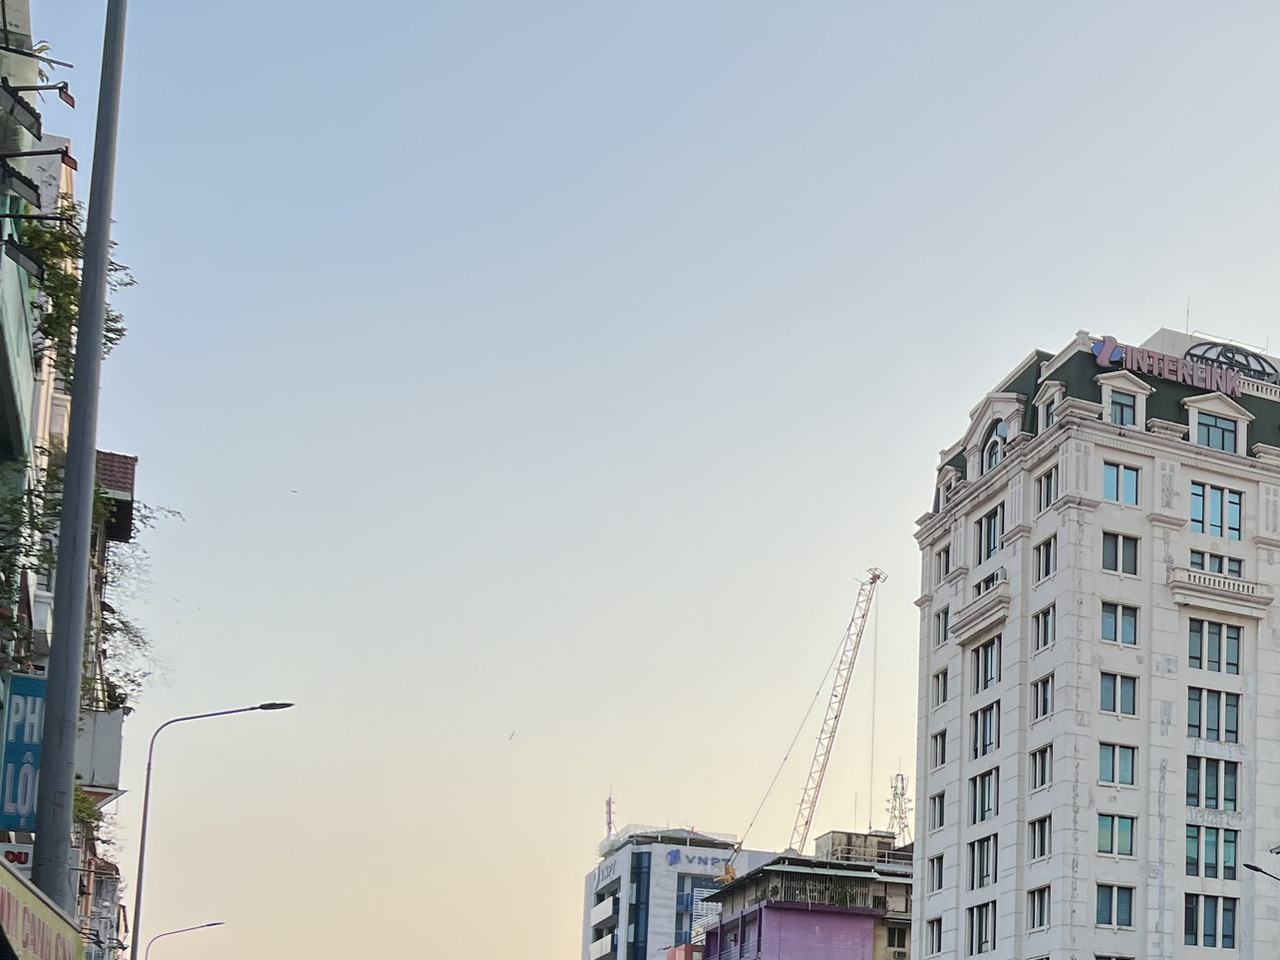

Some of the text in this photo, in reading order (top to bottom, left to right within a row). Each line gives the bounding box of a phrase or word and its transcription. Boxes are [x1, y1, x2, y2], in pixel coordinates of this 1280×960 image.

[1123, 346, 1242, 397] INTERLINK
[8, 695, 46, 745] PH
[3, 752, 40, 829] LỘ
[685, 854, 731, 866] VNPT
